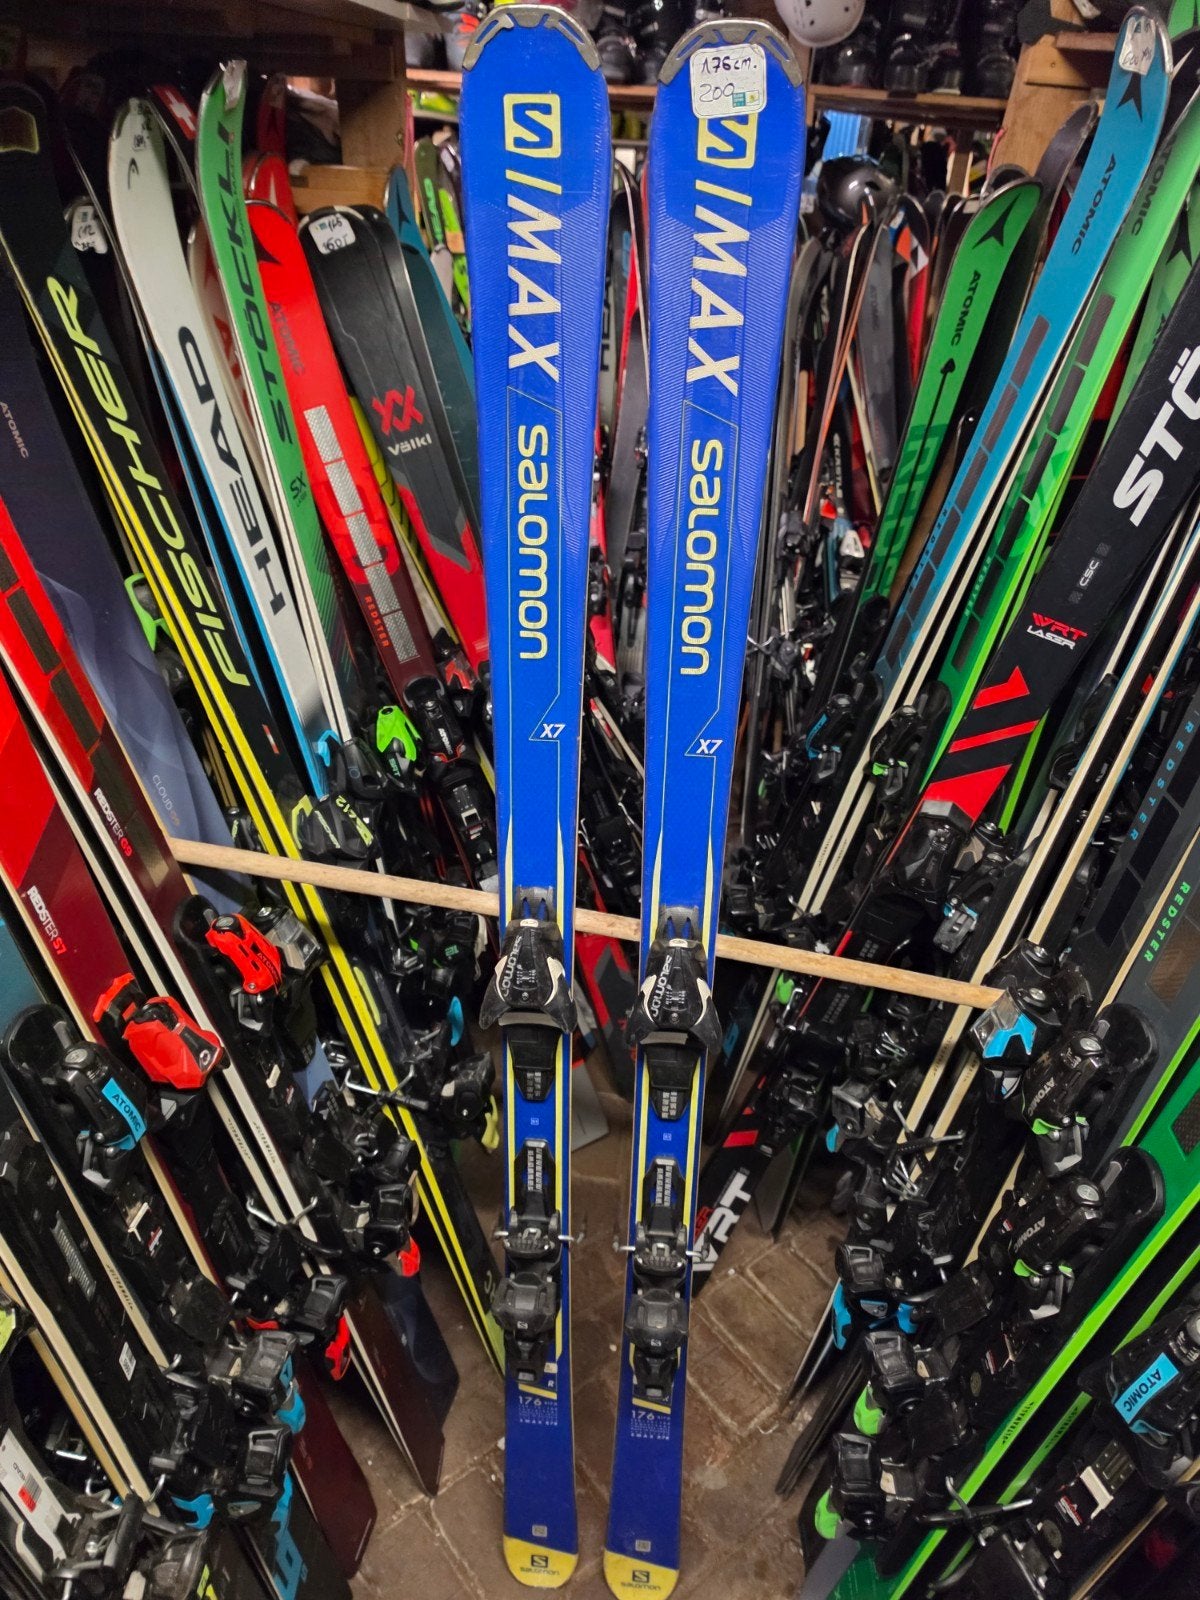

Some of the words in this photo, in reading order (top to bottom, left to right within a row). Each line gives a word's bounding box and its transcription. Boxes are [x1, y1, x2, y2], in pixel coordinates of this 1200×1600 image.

[699, 82, 735, 102] 200
[1072, 153, 1117, 257] ATOMIC
[951, 270, 982, 347] ATOMIC
[268, 301, 305, 376] ATOMIC
[1, 403, 29, 458] ATOMIC
[47, 277, 250, 687] FISCHER
[178, 326, 286, 616] HEAD
[517, 425, 548, 660] salomon
[680, 439, 723, 676] salomon
[1080, 558, 1098, 586] CSC
[364, 595, 390, 648] REDSTER
[1026, 624, 1076, 650] LASER
[1033, 612, 1087, 638] WRT
[540, 723, 565, 739] X7
[696, 739, 722, 754] X7
[152, 774, 174, 812] CLOUD
[1130, 719, 1194, 842] REDSTER
[94, 788, 126, 840] REDSTER
[27, 886, 58, 941] REDSTER
[54, 936, 67, 955] S7
[1142, 881, 1191, 962] REDSTER
[111, 1092, 143, 1134] ATOMIC
[1028, 1076, 1056, 1117] ATOMIC
[1013, 1216, 1046, 1256] ATOMIC
[518, 1396, 542, 1406] 176
[631, 1410, 655, 1420] 176
[1126, 1367, 1163, 1414] ATOMIC
